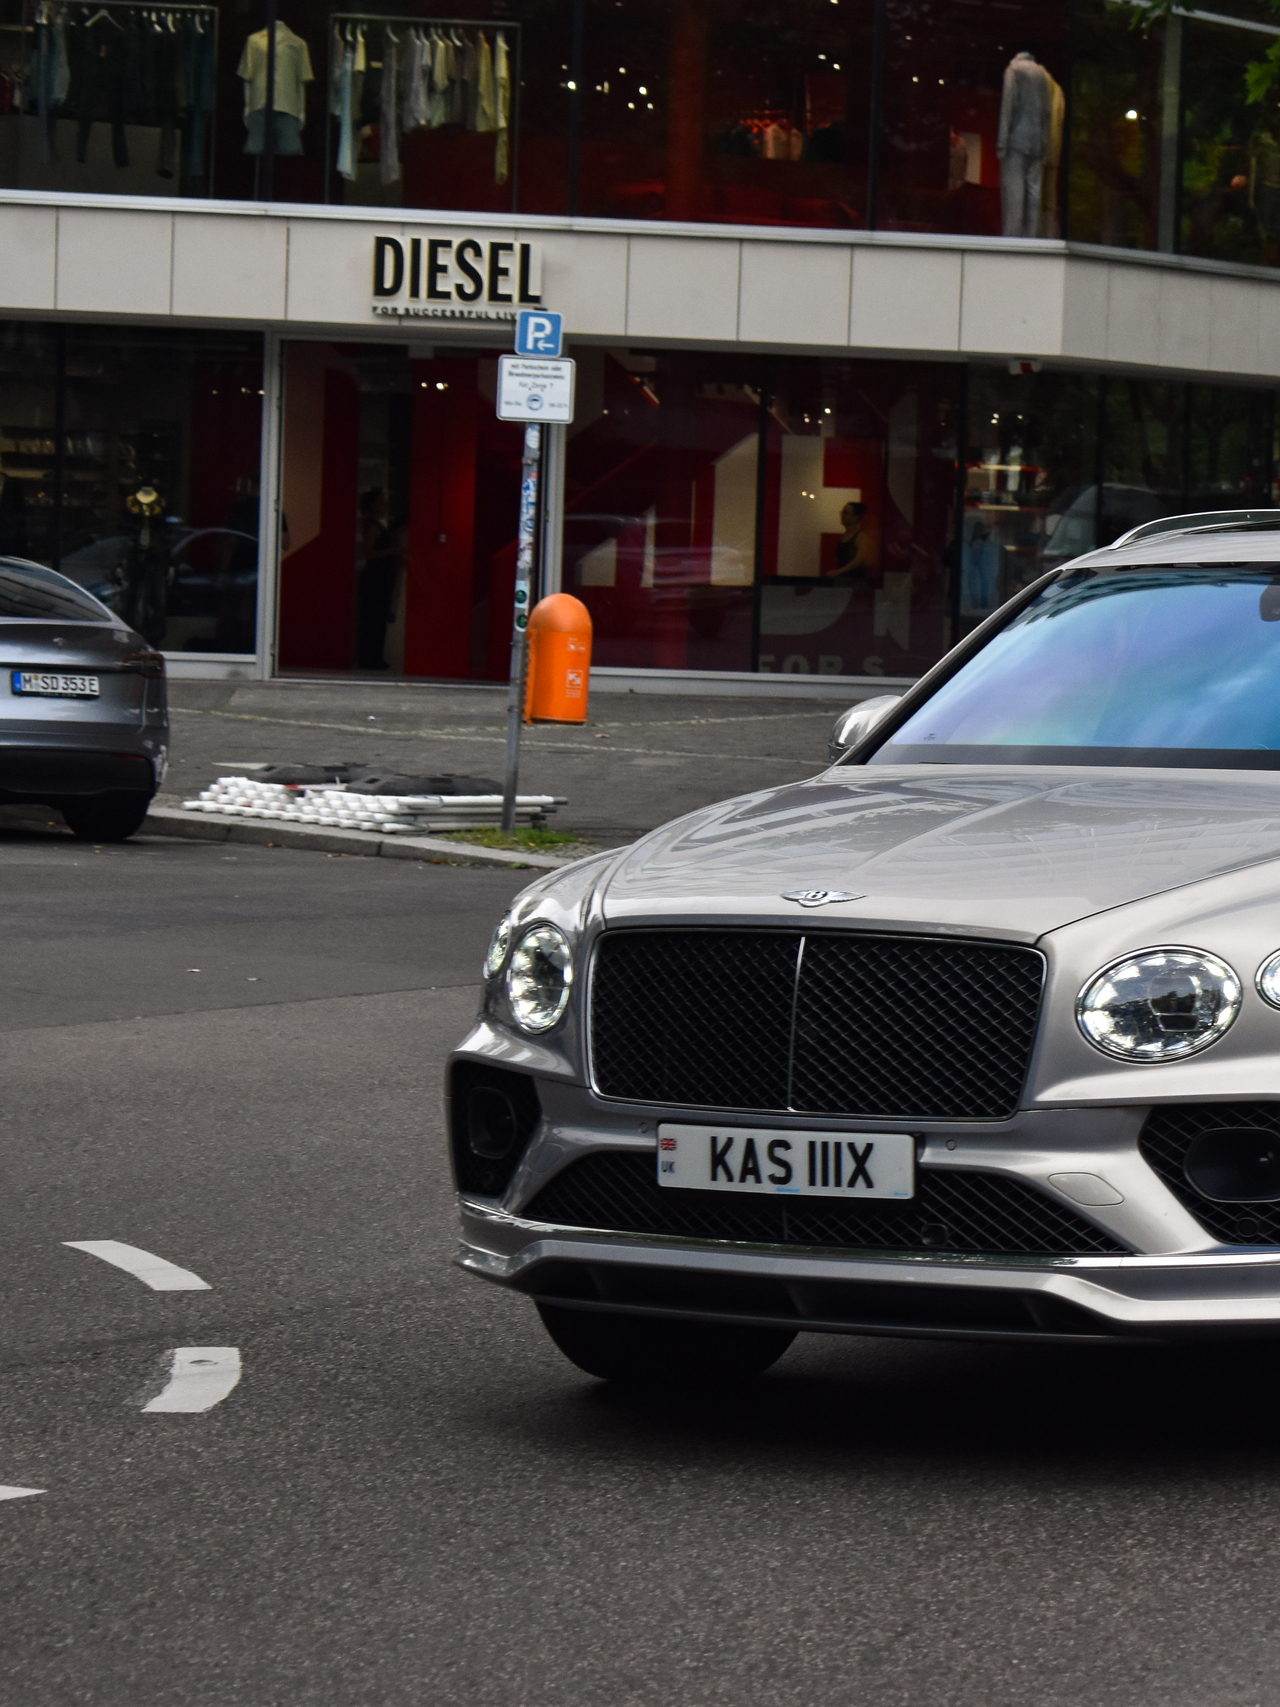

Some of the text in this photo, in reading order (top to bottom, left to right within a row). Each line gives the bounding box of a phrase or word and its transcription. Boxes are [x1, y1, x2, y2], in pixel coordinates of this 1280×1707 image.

[373, 236, 542, 304] DIESEL
[372, 305, 399, 316] FOR
[404, 307, 491, 320] SUCCESSFUL
[526, 316, 553, 350] P
[41, 675, 58, 690] SD
[661, 1161, 675, 1173] UK
[710, 1135, 793, 1185] KAS
